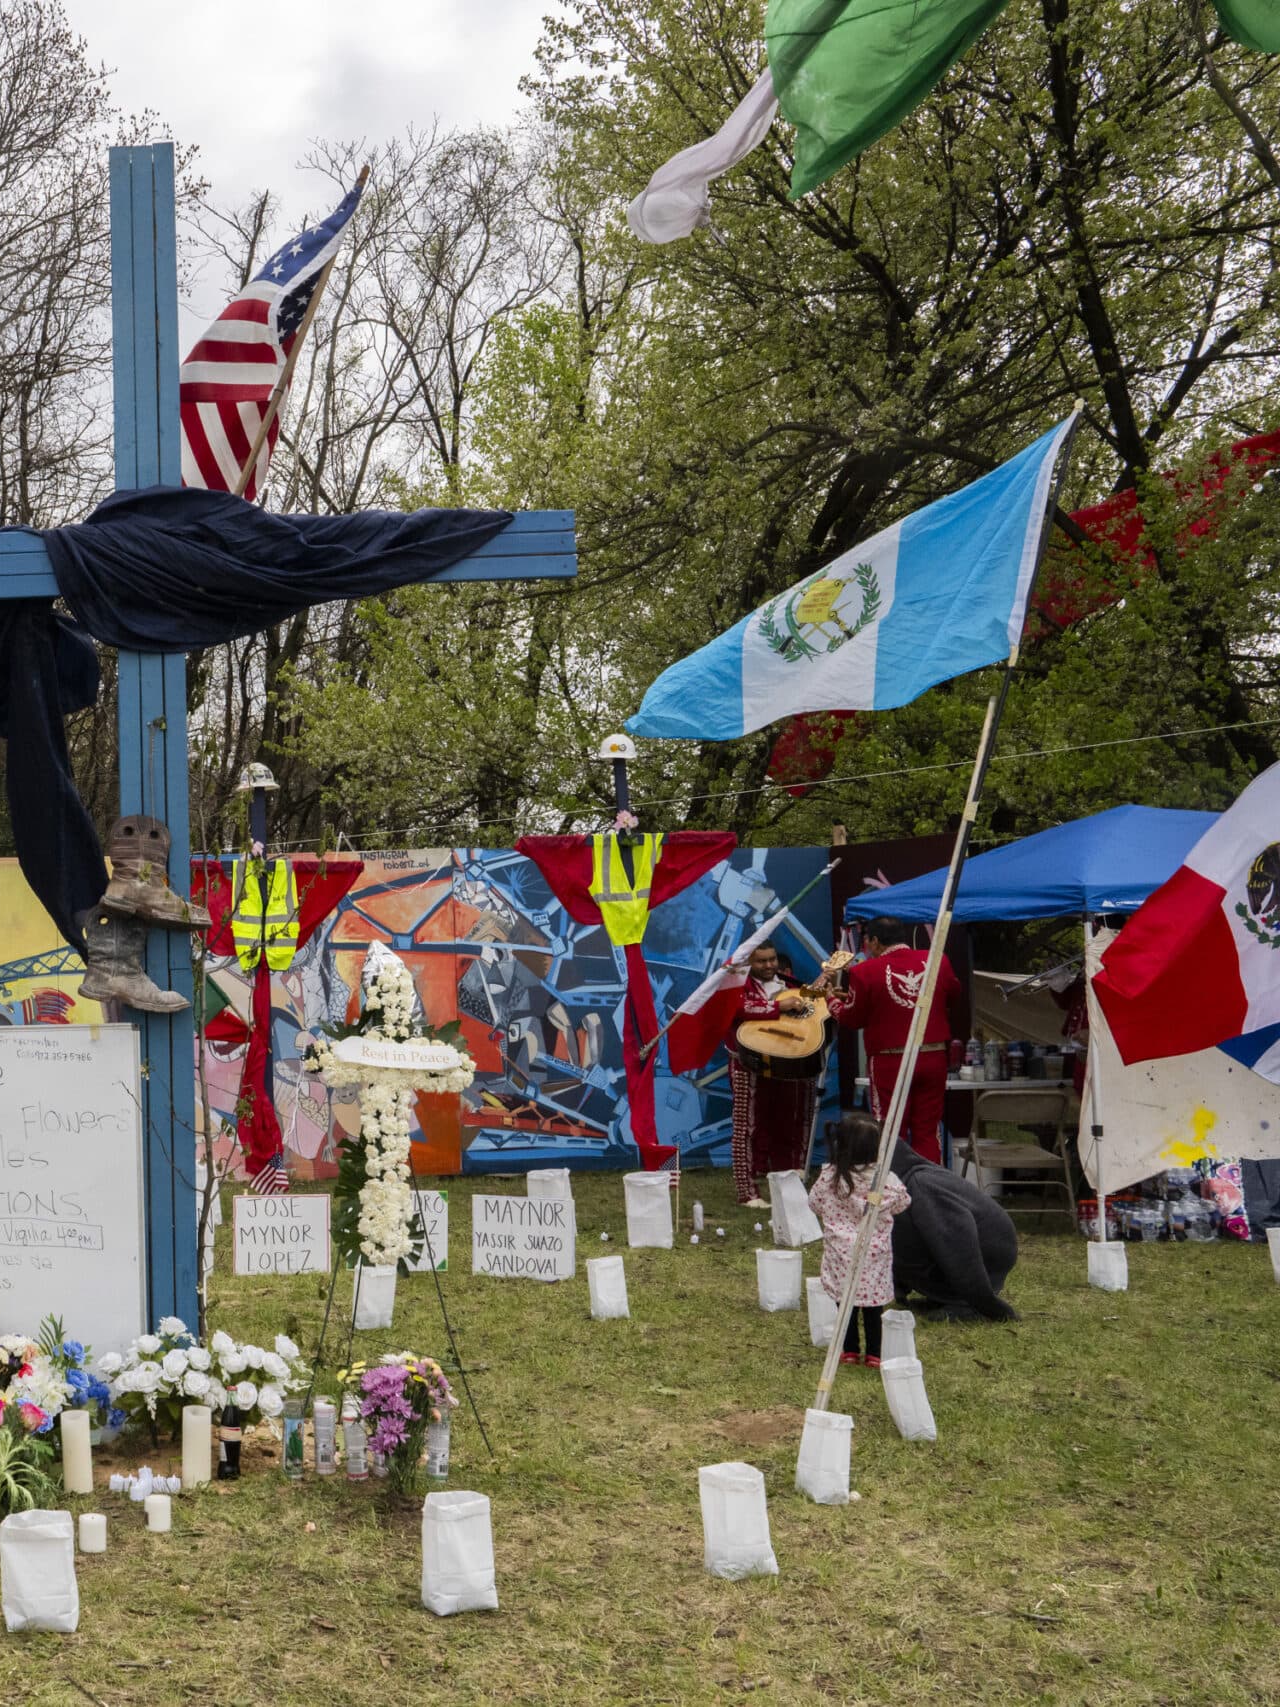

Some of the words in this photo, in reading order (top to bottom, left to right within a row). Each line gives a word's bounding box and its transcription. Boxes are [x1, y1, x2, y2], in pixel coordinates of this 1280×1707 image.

[360, 849, 408, 860] INSTAGRAM
[361, 1045, 388, 1059] Rest
[392, 1050, 406, 1062] in
[411, 1051, 450, 1064] Peace
[21, 1099, 131, 1139] Flowers
[246, 1197, 303, 1218] JOSE
[484, 1199, 566, 1228] MAYNOR
[5, 1219, 51, 1247] Vigilia
[239, 1223, 316, 1245] MYNOR
[475, 1230, 517, 1250] YASSIR
[524, 1234, 563, 1252] SUAZO
[247, 1249, 315, 1273] LOPEZ
[480, 1252, 564, 1277] SANDOVAL
